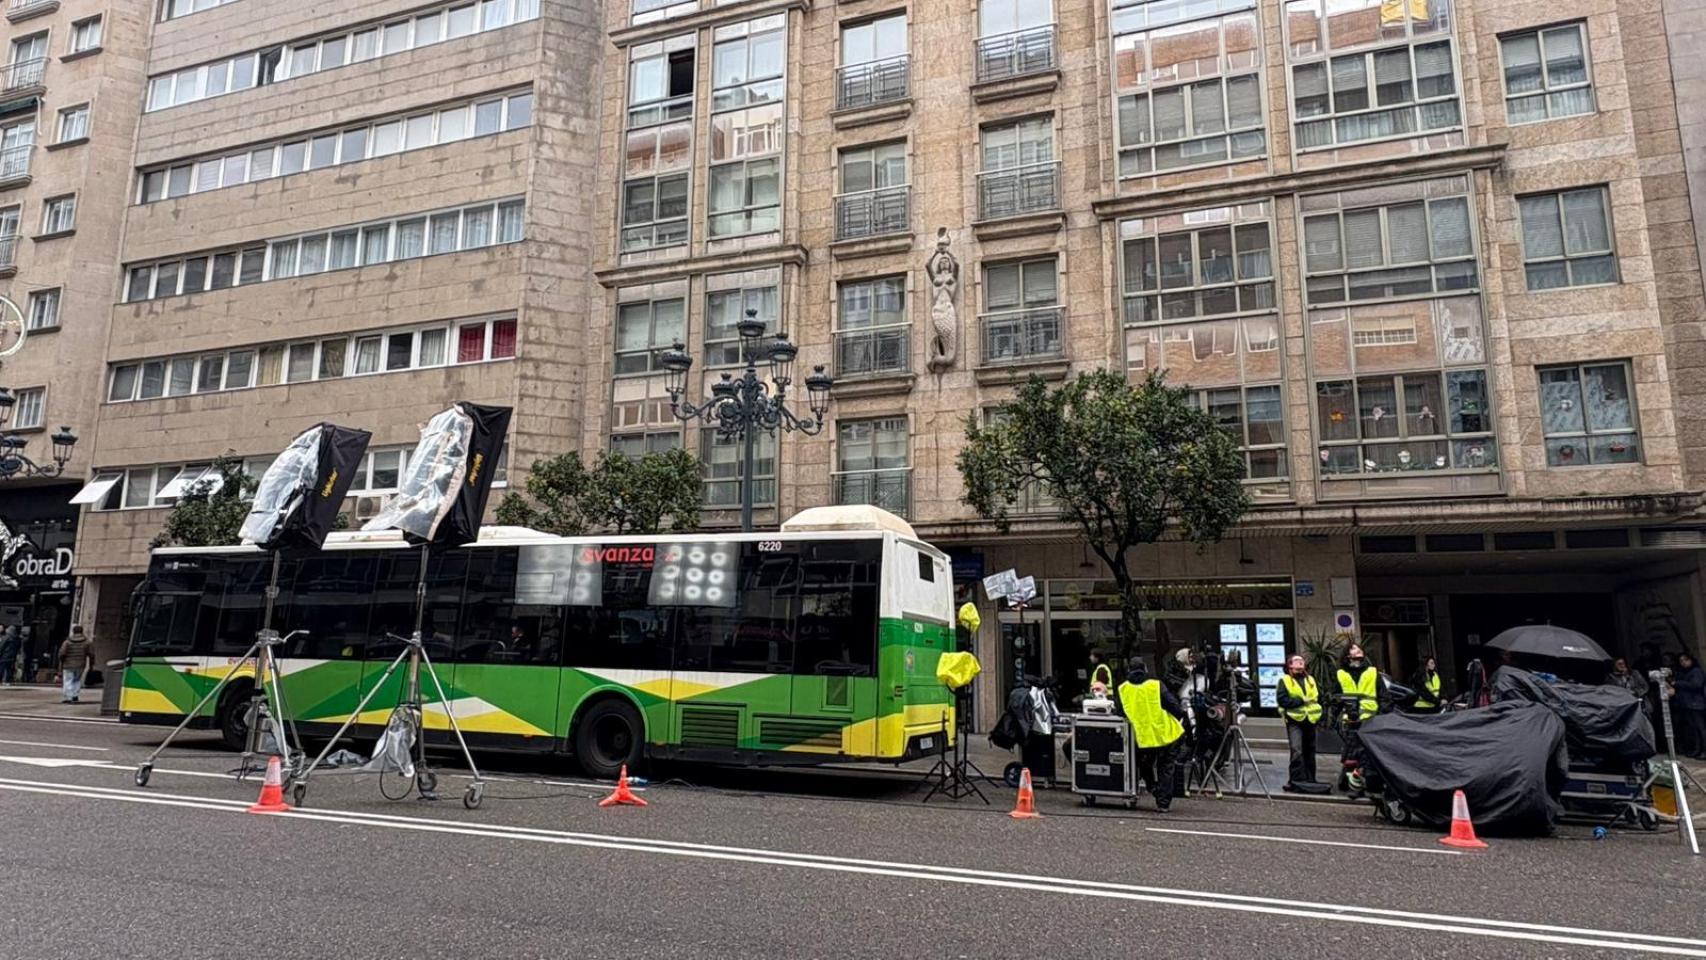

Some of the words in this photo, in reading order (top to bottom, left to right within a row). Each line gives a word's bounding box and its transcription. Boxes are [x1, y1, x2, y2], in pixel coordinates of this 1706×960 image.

[758, 541, 782, 551] 6220
[16, 548, 73, 576] obraD
[584, 547, 654, 562] avanza
